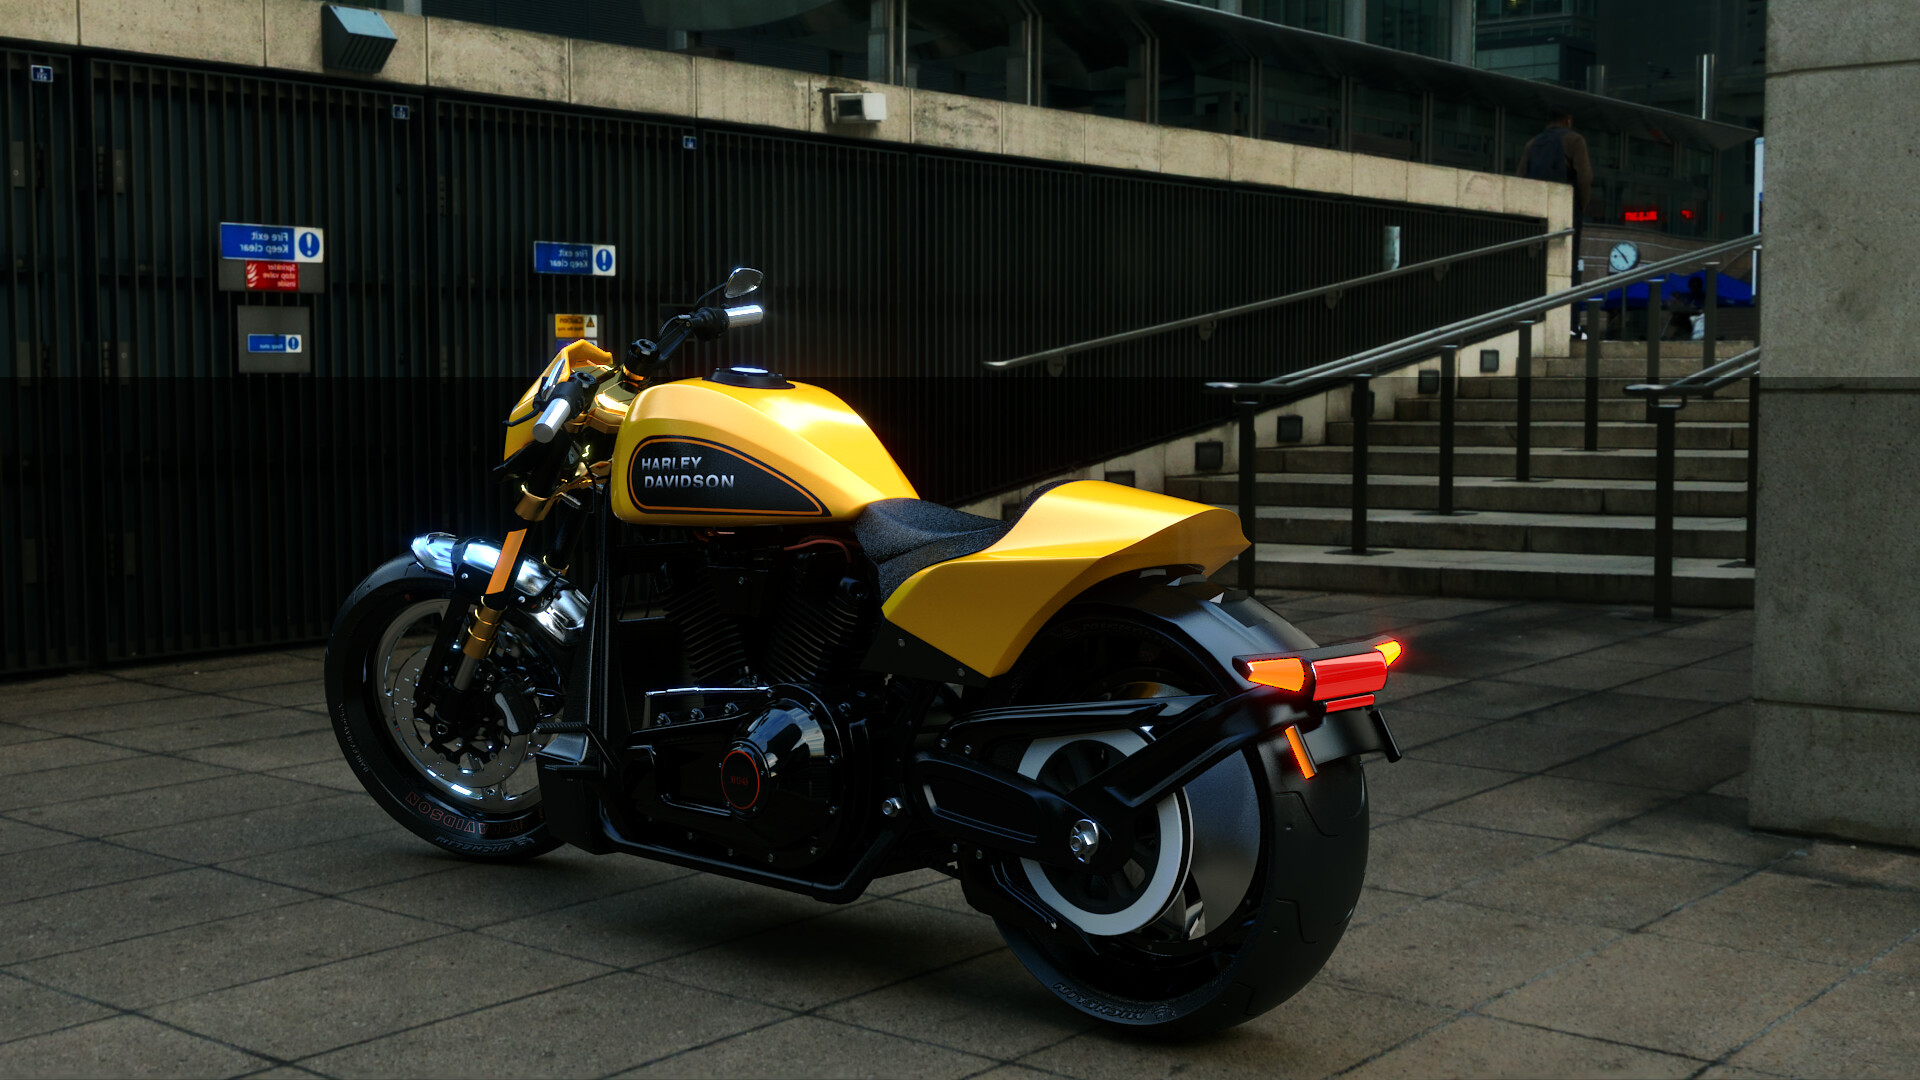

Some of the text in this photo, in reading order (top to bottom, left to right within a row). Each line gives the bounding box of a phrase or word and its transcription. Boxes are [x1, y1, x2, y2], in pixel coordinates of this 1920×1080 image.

[641, 456, 702, 471] HARLEY
[644, 474, 735, 489] DAVIDSON
[434, 835, 512, 853] MICHELIN
[1052, 982, 1147, 1020] MICHELIN
